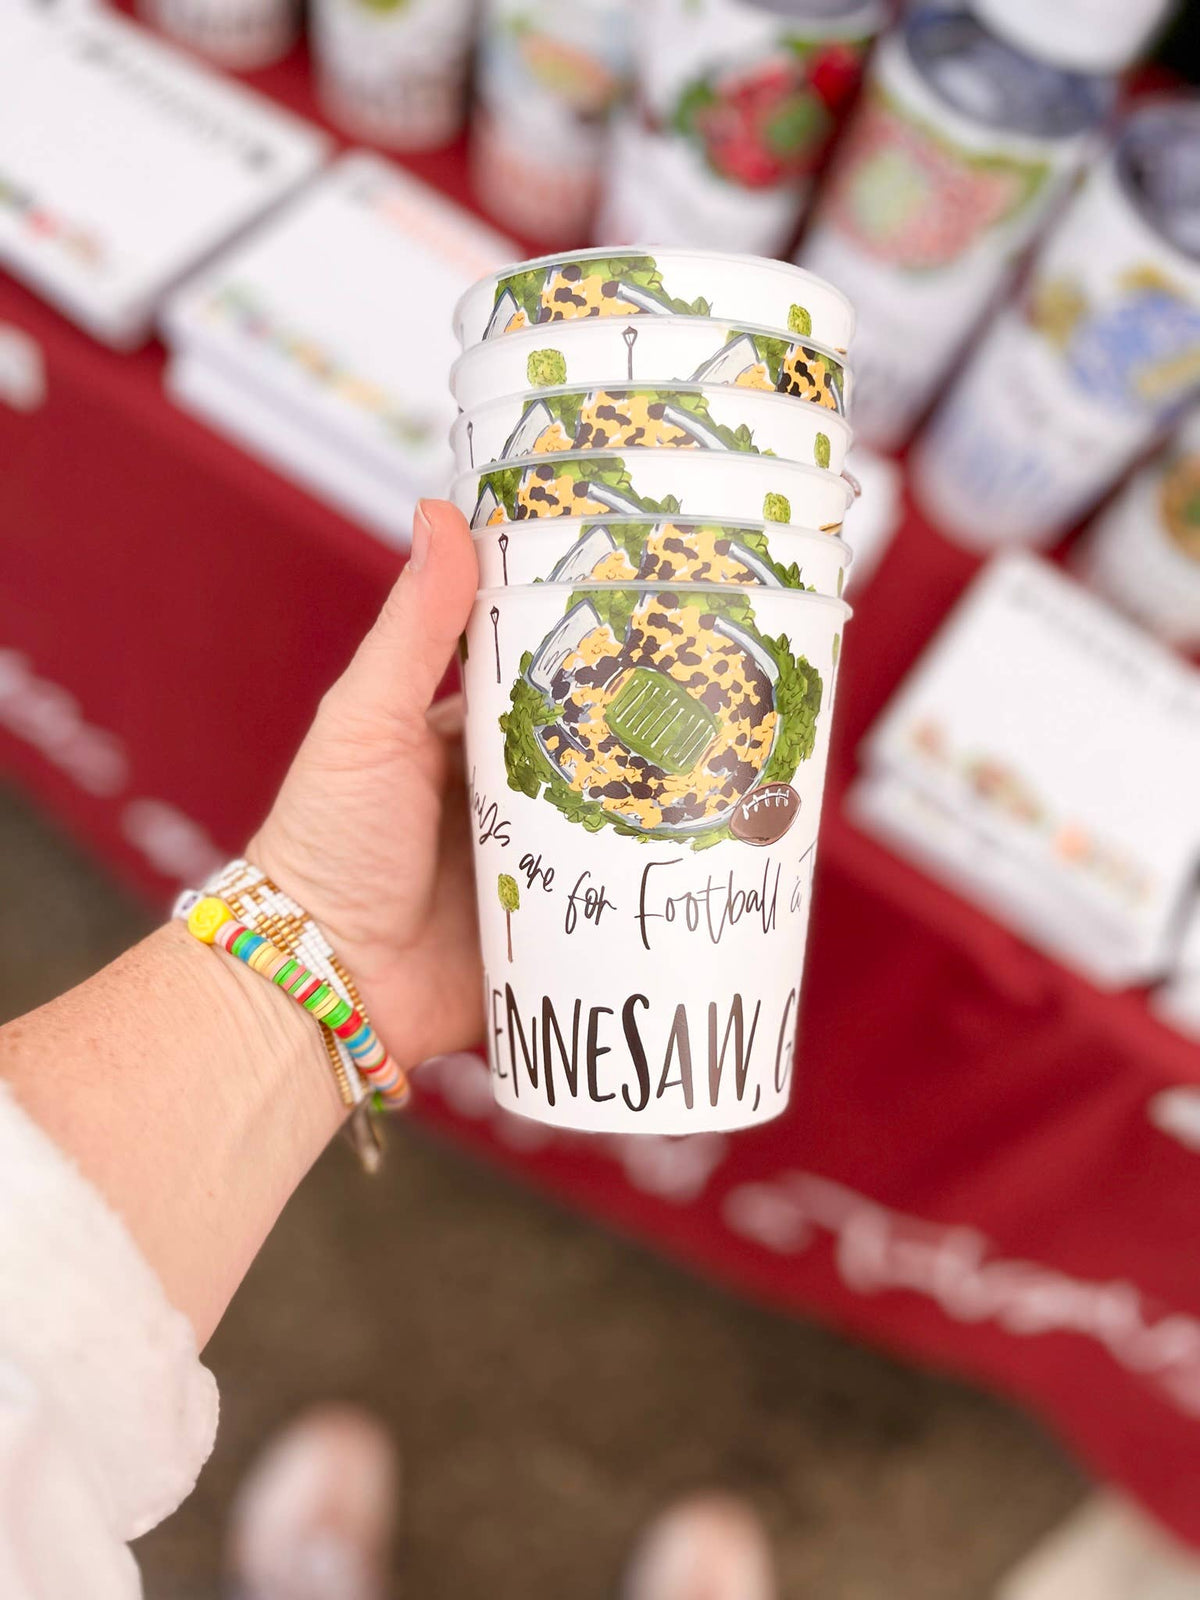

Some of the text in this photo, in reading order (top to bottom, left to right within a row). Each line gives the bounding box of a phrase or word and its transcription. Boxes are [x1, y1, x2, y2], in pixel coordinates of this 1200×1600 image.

[518, 853, 556, 893] are
[565, 870, 617, 934] for
[634, 857, 781, 950] Football
[486, 973, 761, 1112] ENNESAW,
